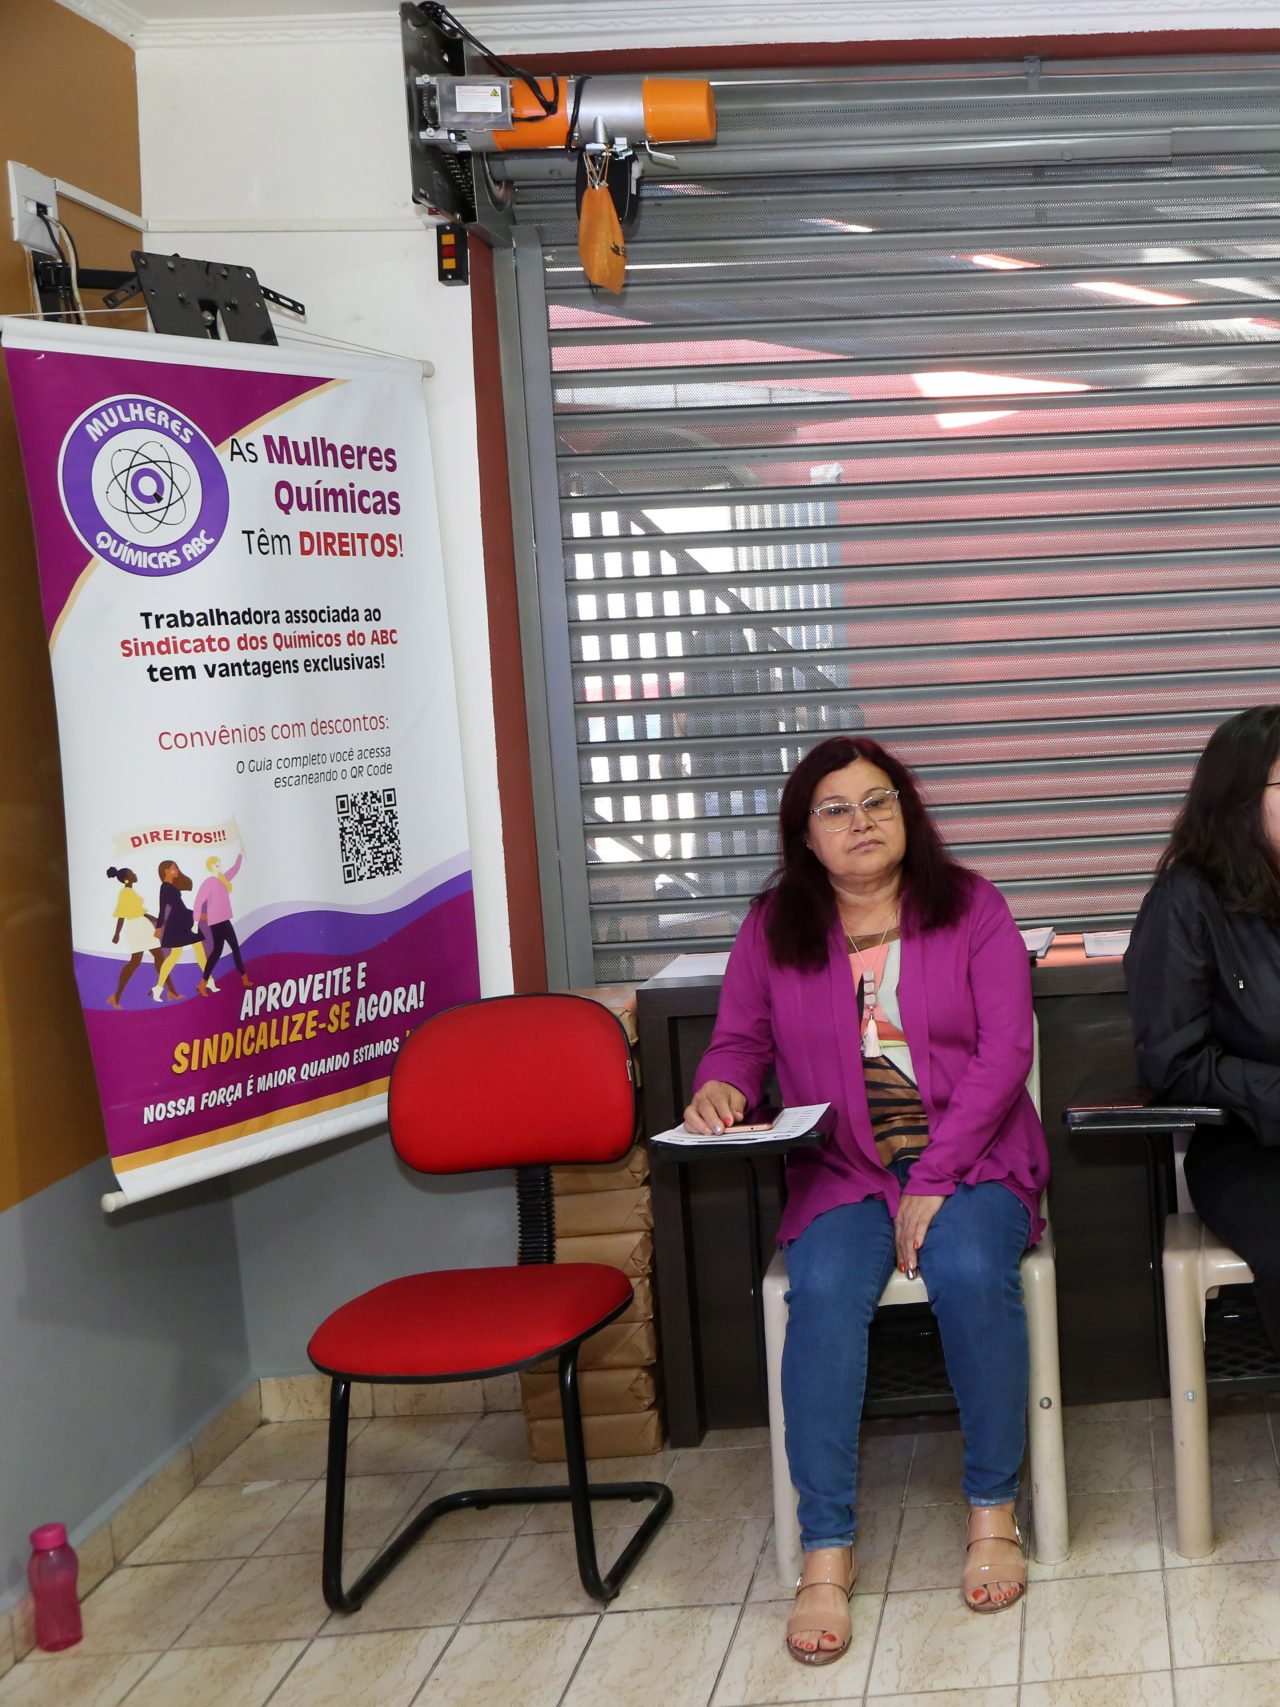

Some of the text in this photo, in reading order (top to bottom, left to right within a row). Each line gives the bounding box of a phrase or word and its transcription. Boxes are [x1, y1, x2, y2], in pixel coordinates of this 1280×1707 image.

[85, 403, 193, 443] MULHERES
[230, 434, 398, 472] As Mulheres
[274, 479, 401, 515] Químicas
[95, 528, 215, 569] QUÍMICAS ABC
[241, 527, 404, 558] Têm DIREITOS!
[139, 605, 382, 630] Trabalhadora associada ao
[120, 628, 399, 658] Sindicato dos Químicos do ABC
[146, 652, 386, 683] tem vantagens exclusivas!
[158, 713, 390, 751] Convênios com descontos:
[236, 745, 391, 774] O Guia completo você acessa
[274, 762, 393, 789] escaneando o QR Code
[130, 829, 227, 849] DIREITOS!!!
[240, 961, 368, 1021] APROVEITE E
[171, 980, 426, 1074] SINDICALIZE-SE AGORA!
[143, 1036, 400, 1125] NOSSA FORÇA É MAIOR QUANDO ESTAMOS
